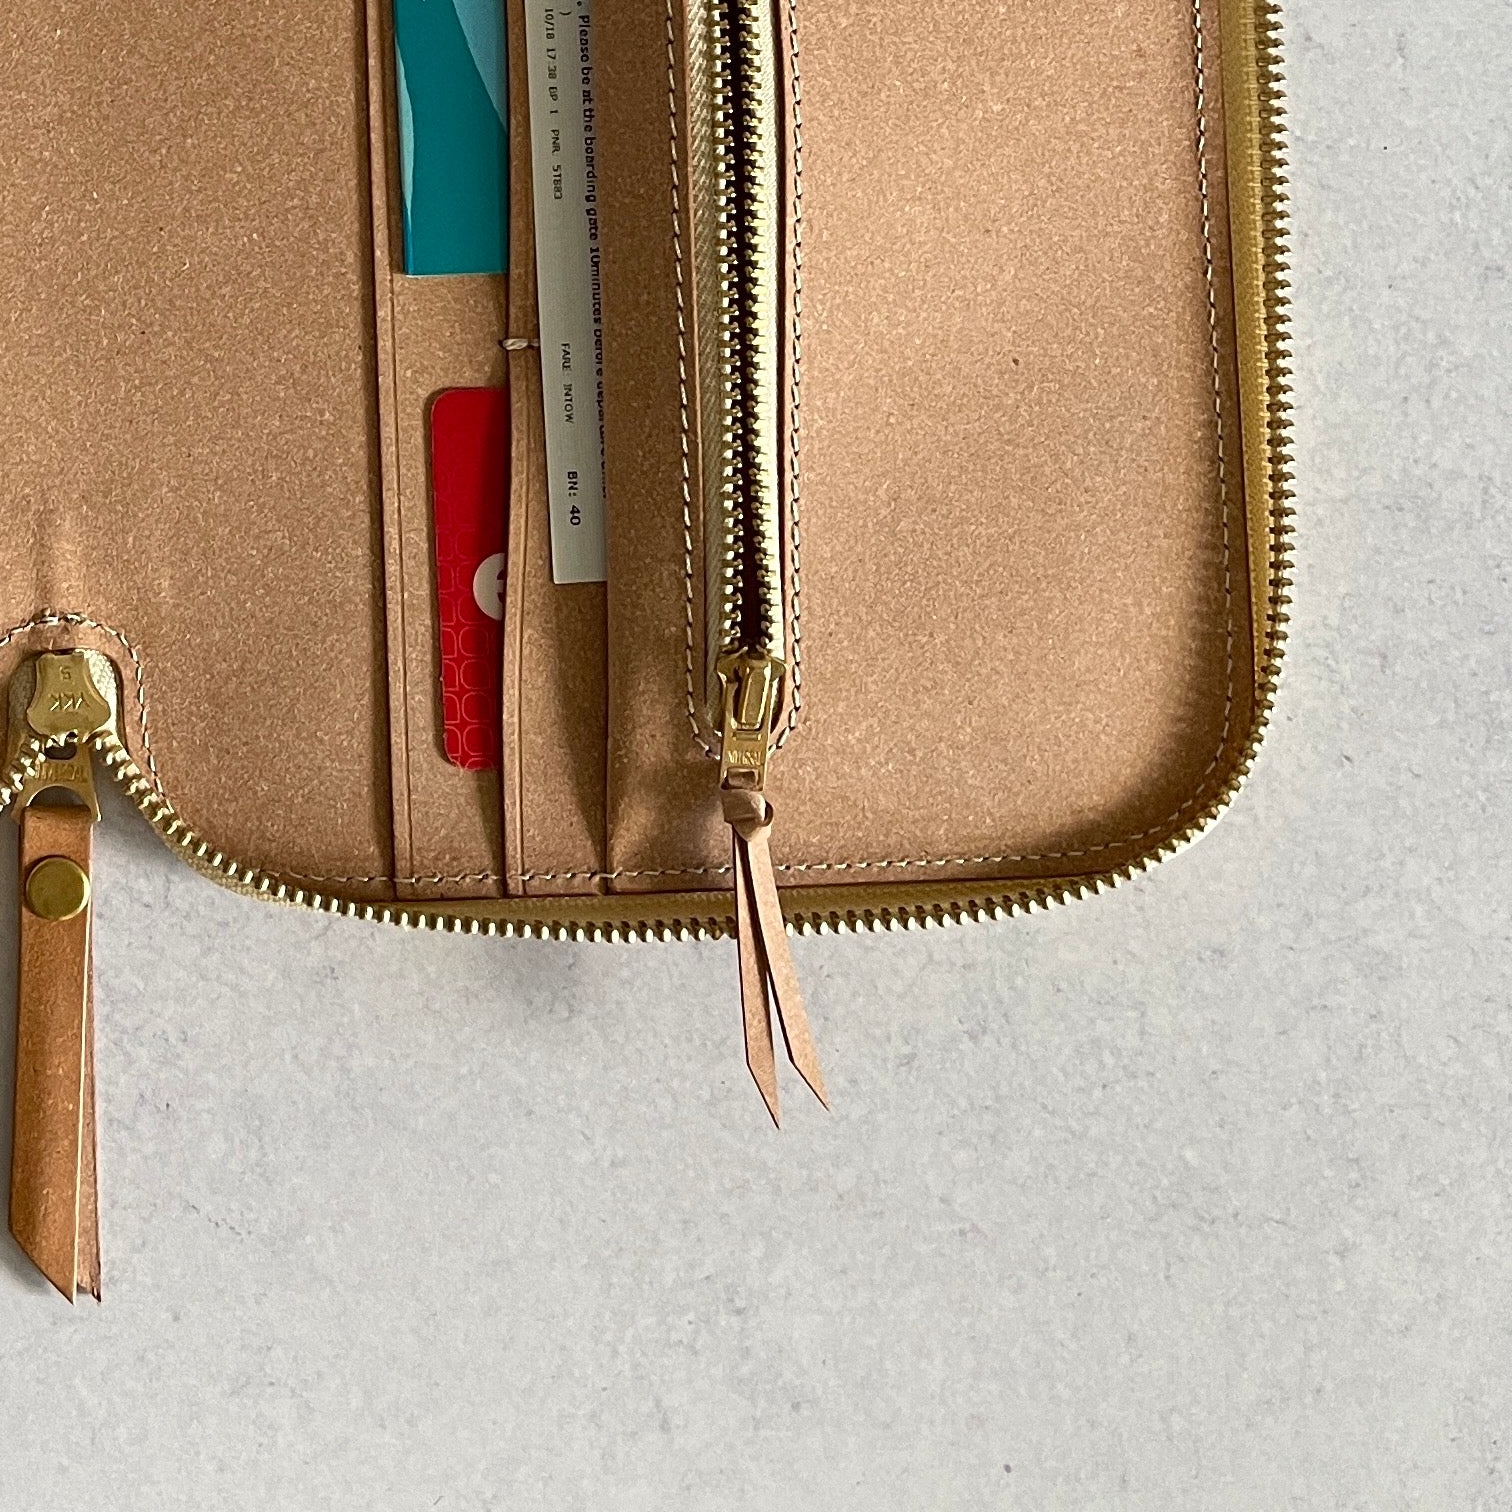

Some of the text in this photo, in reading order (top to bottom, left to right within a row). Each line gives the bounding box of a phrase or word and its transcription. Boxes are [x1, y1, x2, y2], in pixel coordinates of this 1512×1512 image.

[544, 8, 555, 40] 10/18
[578, 15, 591, 63] Please
[581, 67, 594, 85] be
[583, 90, 595, 104] at
[583, 108, 595, 132] the
[584, 137, 597, 203] boarding
[585, 208, 599, 241] gate
[567, 471, 581, 526] BN: 40
[48, 691, 90, 711] YKK
